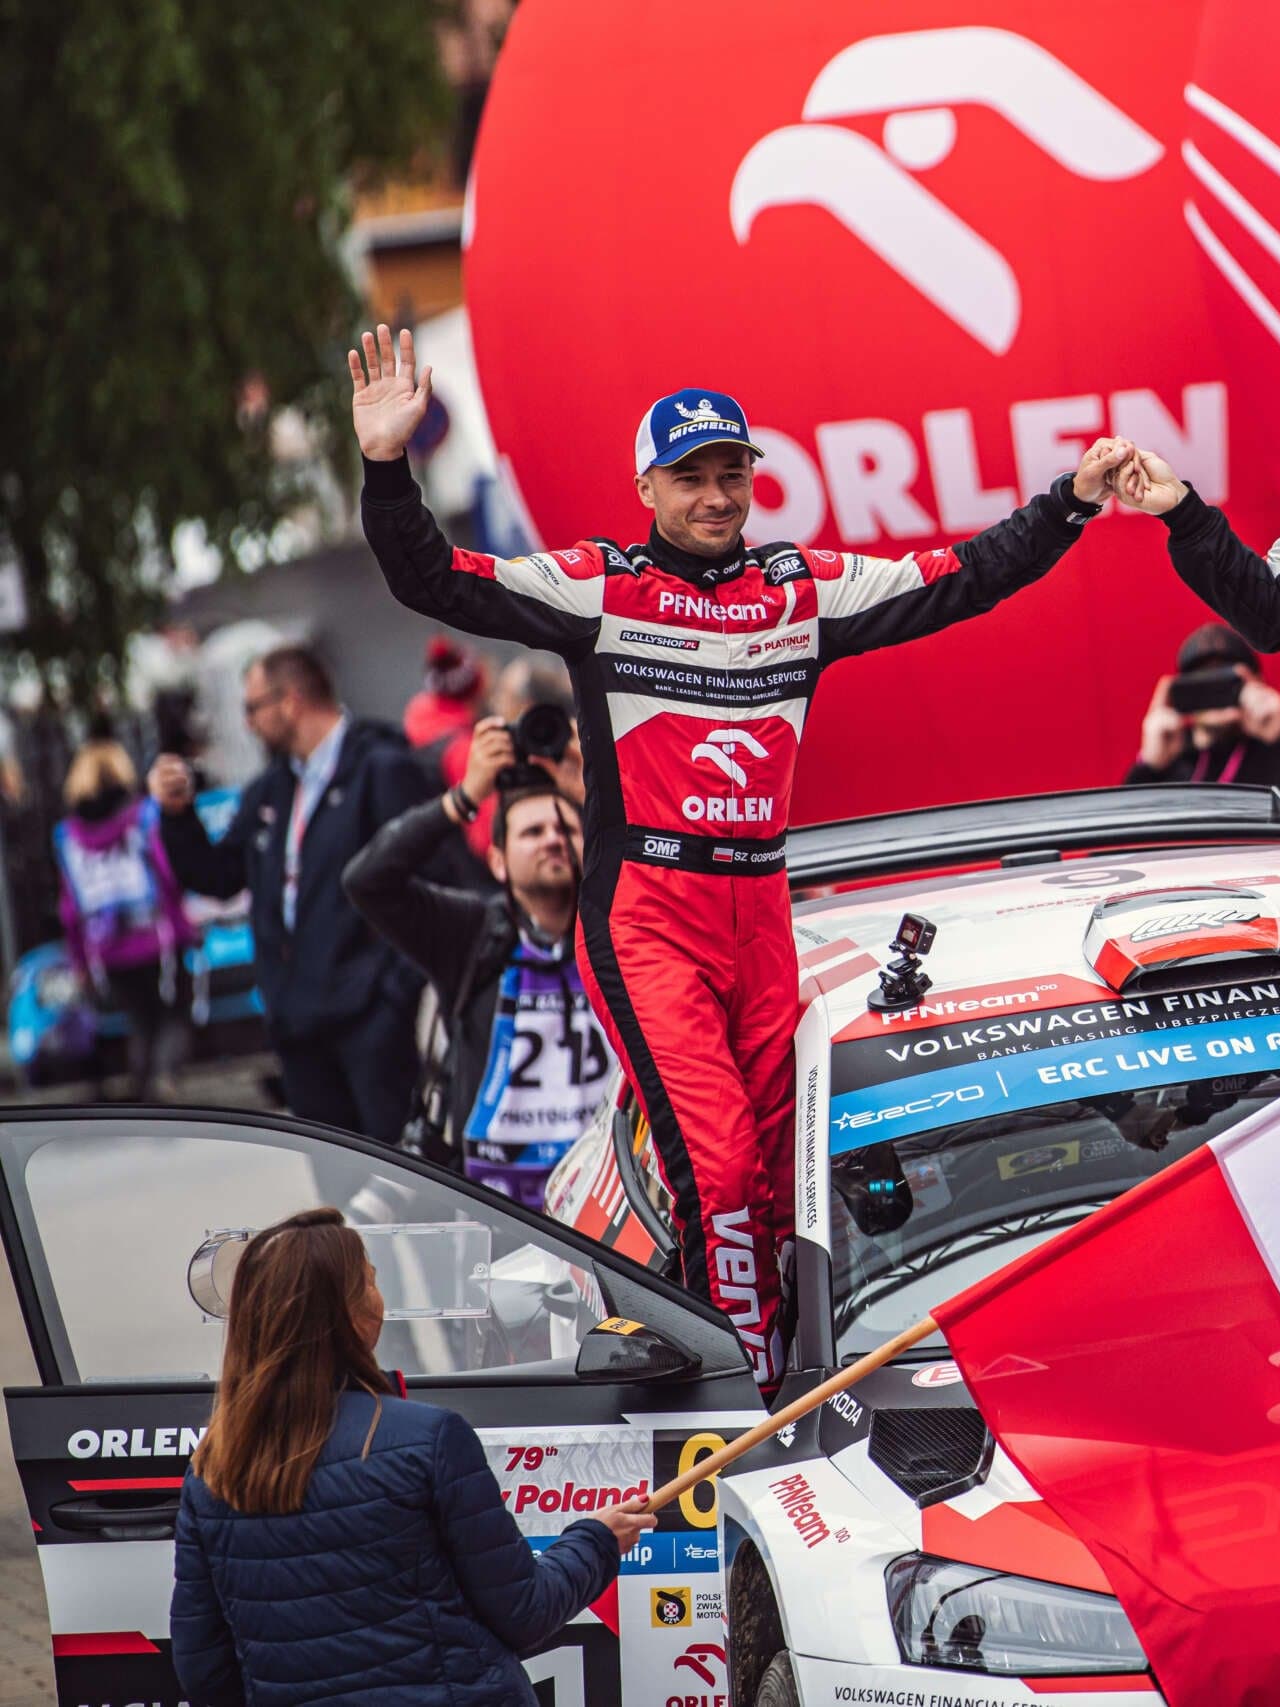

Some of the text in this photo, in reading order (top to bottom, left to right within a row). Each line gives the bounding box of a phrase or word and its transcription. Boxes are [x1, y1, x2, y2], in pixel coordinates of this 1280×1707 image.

[668, 421, 741, 444] MICHELIN
[745, 382, 1229, 547] ORLEN
[771, 558, 801, 580] OMP
[658, 591, 767, 621] PFNteam
[621, 630, 698, 649] RALLYSHOP.PL
[764, 633, 810, 652] PLATINUM
[614, 661, 808, 690] VOLKSWAGEN FINANCIAL SERVICES
[681, 795, 774, 822] ORLEN
[644, 839, 681, 857] OMP
[881, 983, 1058, 1026] PFNteam 100
[885, 1000, 1150, 1063] VOLKSWAGEN
[977, 1042, 1041, 1062] BANK.
[1050, 1024, 1146, 1048] LEASING.
[1037, 1034, 1257, 1085] ERC LIVE ON
[849, 1083, 986, 1130] ERC70
[805, 1064, 819, 1230] VOLKSWAGEN FINANCIAL SERVICES
[828, 1391, 863, 1427] KODA
[67, 1427, 208, 1459] ORLEN
[514, 1480, 649, 1514] Poland
[677, 1432, 729, 1529] 6
[768, 1473, 851, 1550] PFNteam 100
[696, 1611, 721, 1619] MOTO
[834, 1686, 926, 1707] VOLKSWAGEN
